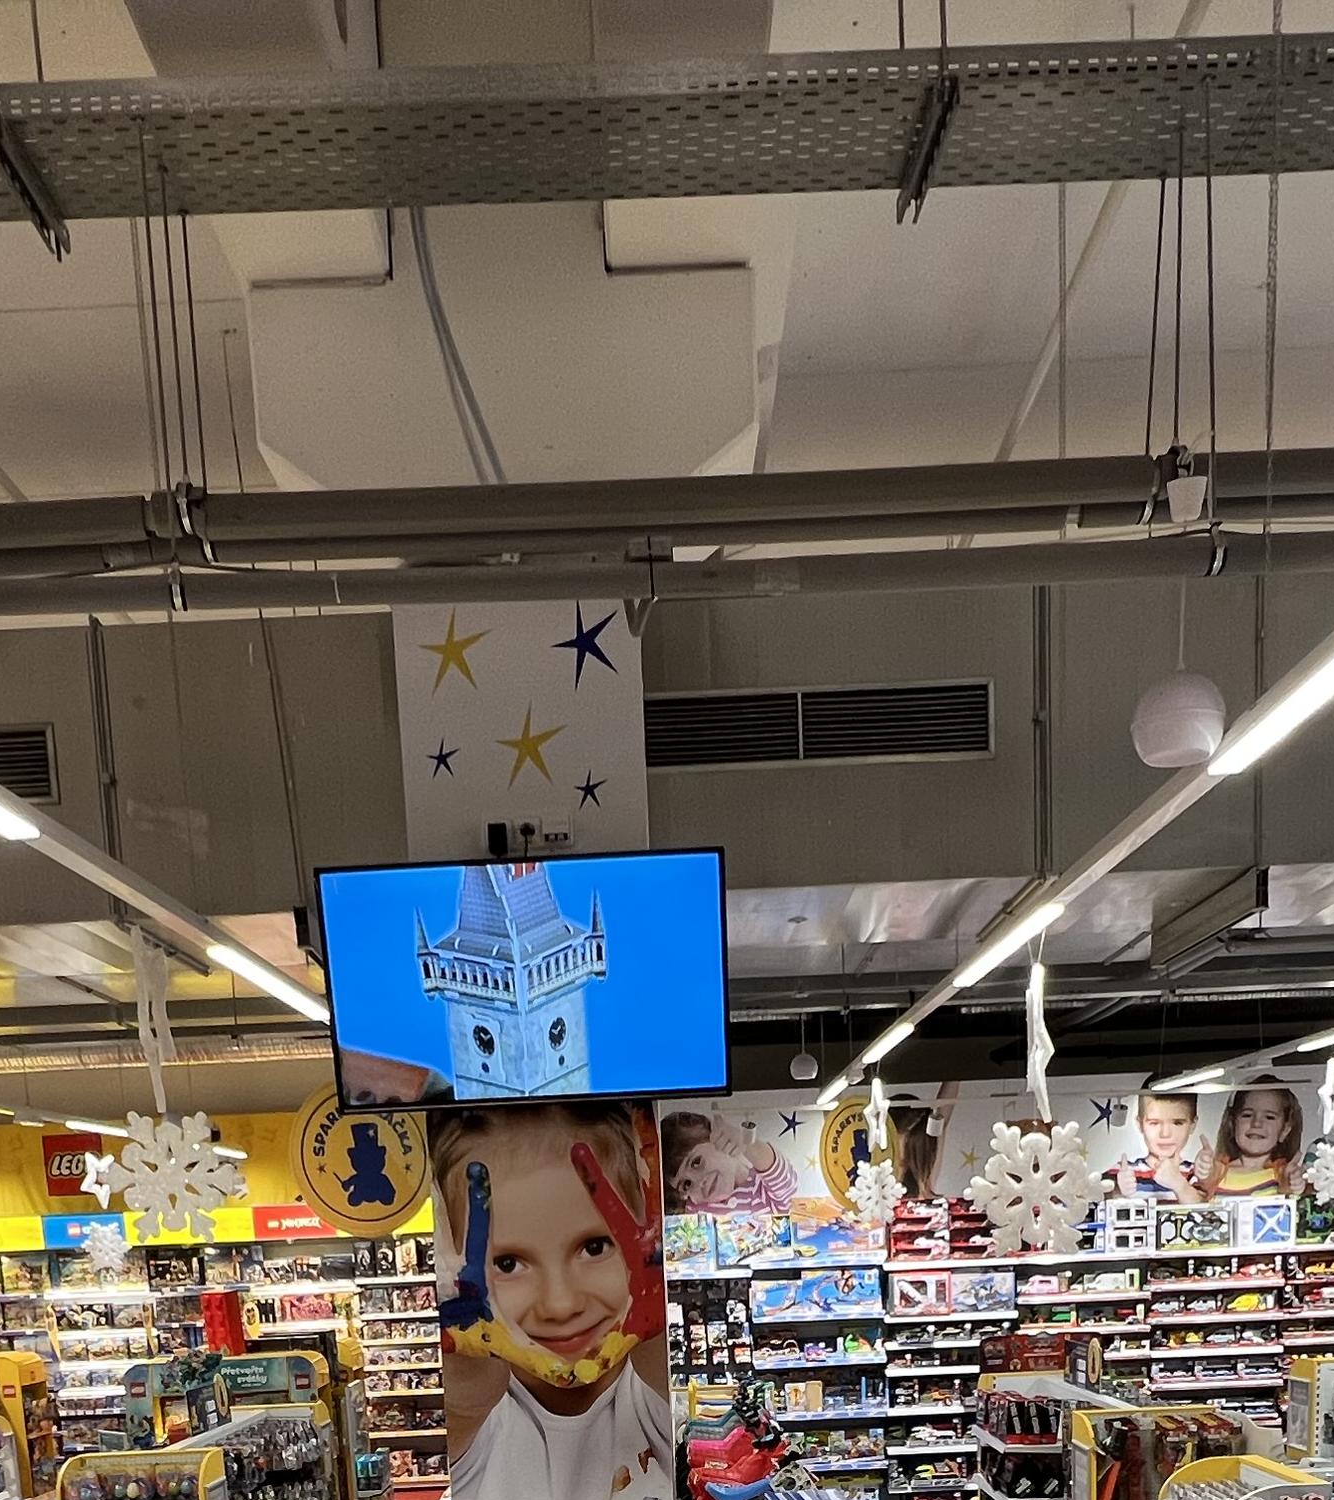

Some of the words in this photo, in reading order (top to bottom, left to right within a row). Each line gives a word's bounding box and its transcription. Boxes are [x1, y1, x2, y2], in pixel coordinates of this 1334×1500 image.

[312, 1107, 342, 1157] SPAR
[384, 1112, 413, 1156] AČKA
[50, 1153, 87, 1177] LEG
